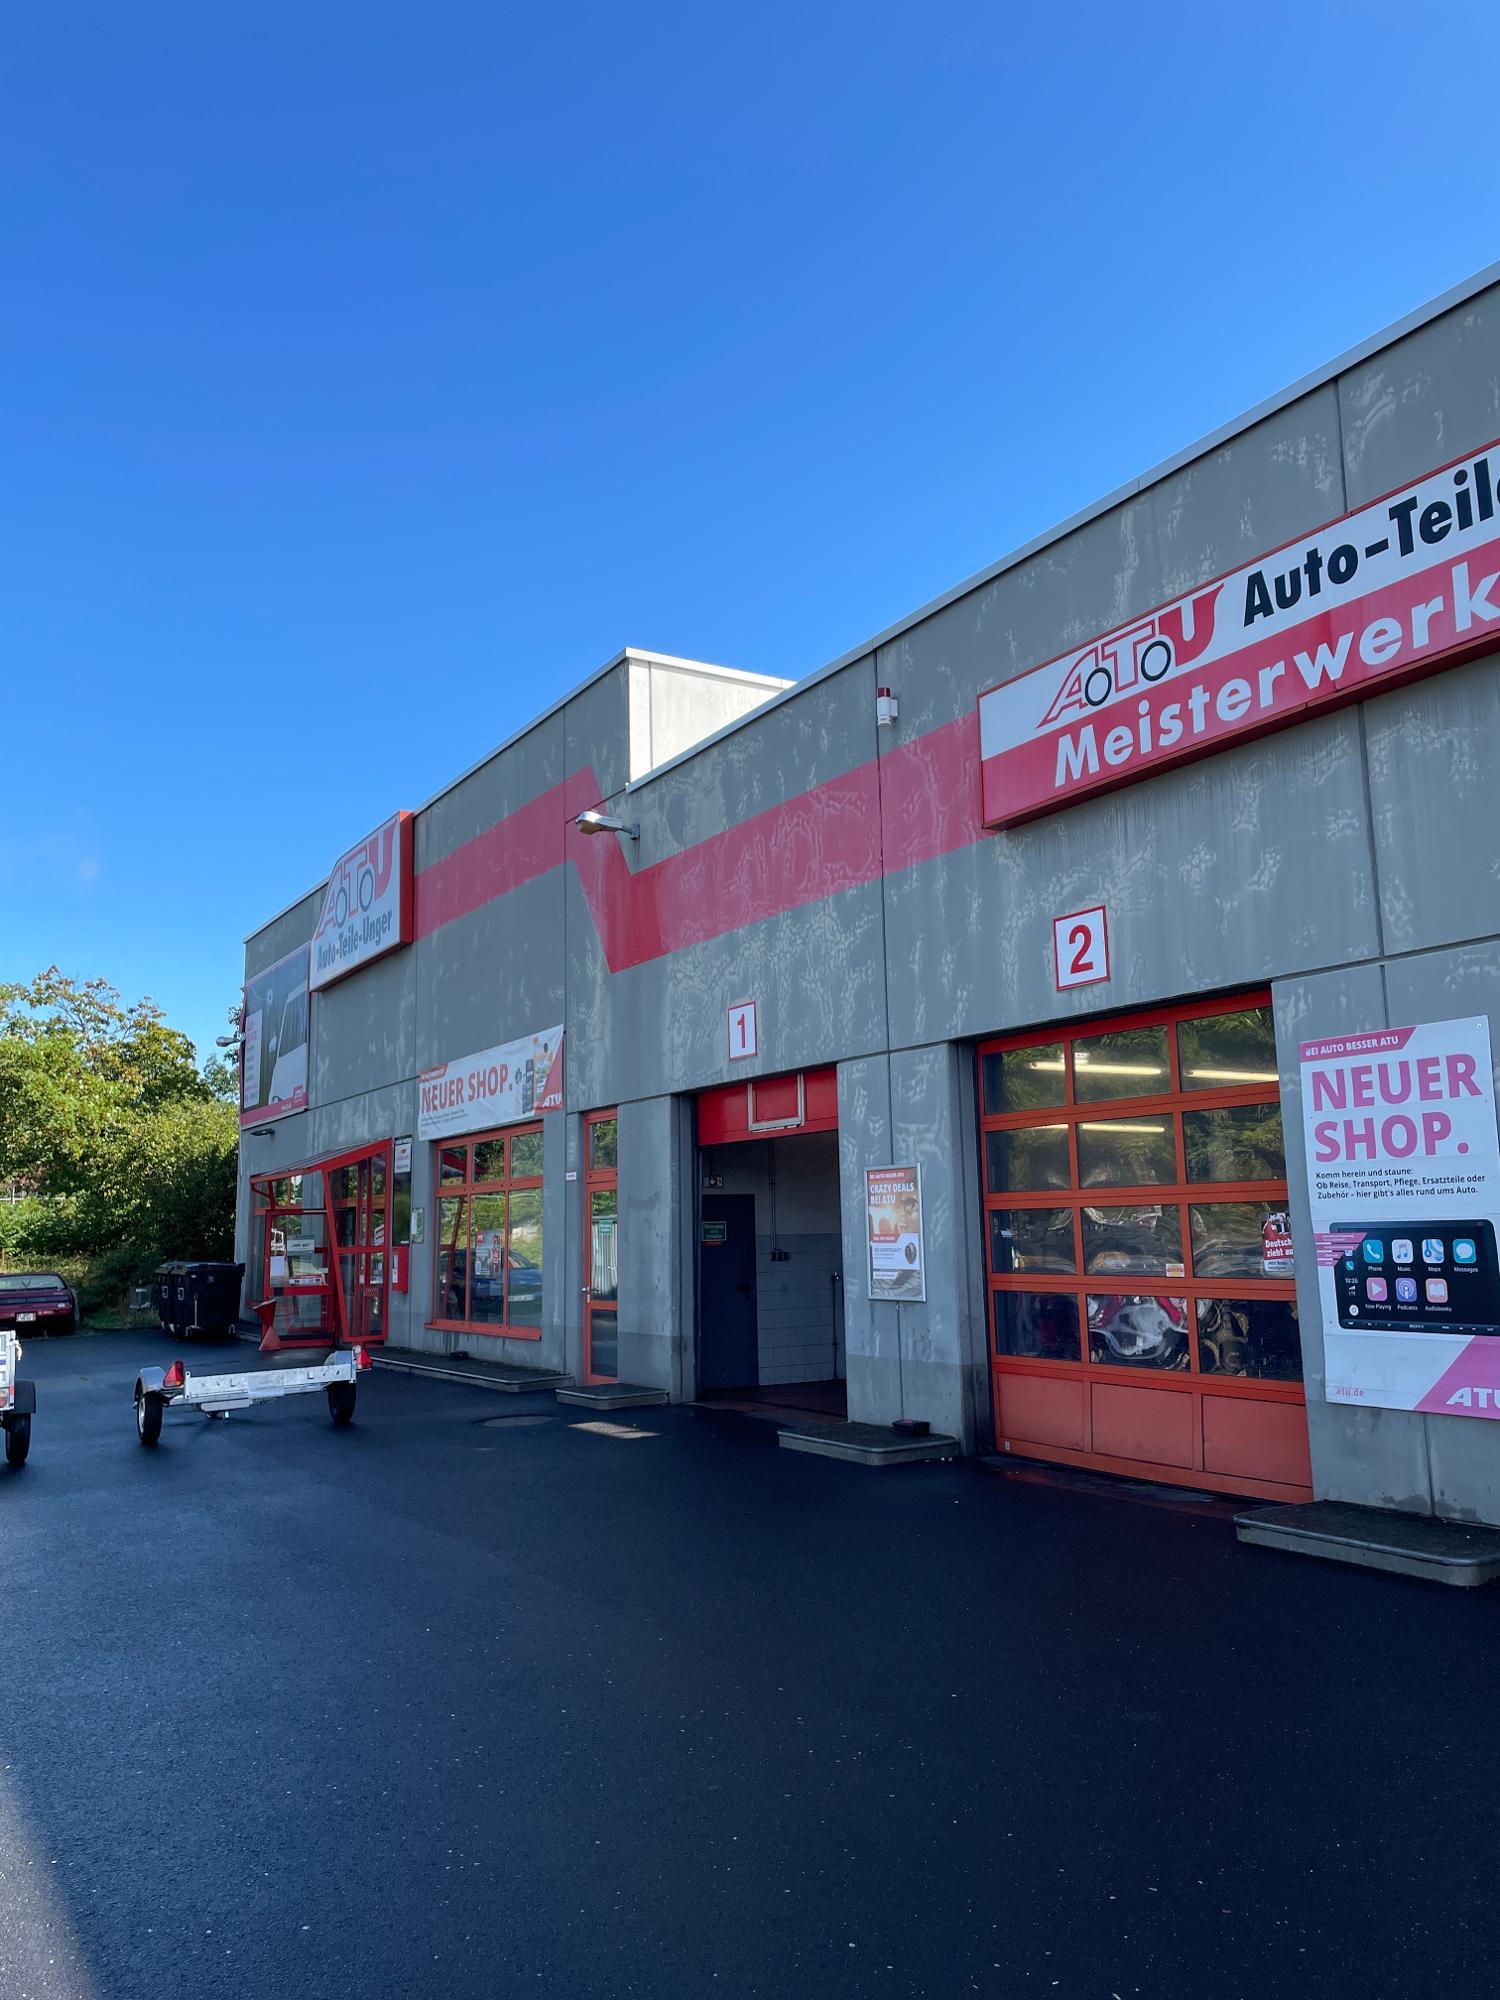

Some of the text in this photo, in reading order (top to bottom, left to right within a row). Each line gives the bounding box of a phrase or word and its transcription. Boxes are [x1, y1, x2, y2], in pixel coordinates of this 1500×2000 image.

[1243, 458, 1500, 627] Auto-Teil
[1055, 560, 1500, 788] Meisterwerk
[316, 908, 392, 972] Auto-Teile-Unger
[1068, 924, 1094, 975] 2
[736, 1013, 747, 1049] 1
[1320, 1043, 1344, 1054] AUTO
[1346, 1039, 1378, 1051] BESSER
[1380, 1035, 1399, 1047] ATU
[421, 1063, 513, 1114] NEUER SHOP.
[1311, 1053, 1483, 1112] NEUER
[542, 1092, 562, 1108] ATU
[1314, 1111, 1469, 1163] SHOP.
[1316, 1181, 1328, 1189] Ob
[1353, 1179, 1392, 1190] Transport,
[1394, 1178, 1421, 1187] Pflege,
[1422, 1175, 1465, 1185] Ersatzteile
[1466, 1174, 1486, 1183] oder
[1341, 1170, 1366, 1178] herein
[1368, 1169, 1383, 1177] und
[1384, 1168, 1414, 1176] staune:
[870, 1182, 915, 1194] CRAZY DEALS
[1317, 1191, 1349, 1199] Zubehör
[1356, 1190, 1372, 1198] hier
[1373, 1189, 1395, 1199] gibt's
[1396, 1188, 1414, 1197] alles
[1416, 1187, 1435, 1196] rund
[1437, 1187, 1454, 1195] ums
[1456, 1186, 1479, 1194] Auto.
[870, 1194, 896, 1205] BEI ATU
[1266, 1248, 1284, 1258] zieht
[1335, 1386, 1365, 1397] atu.de
